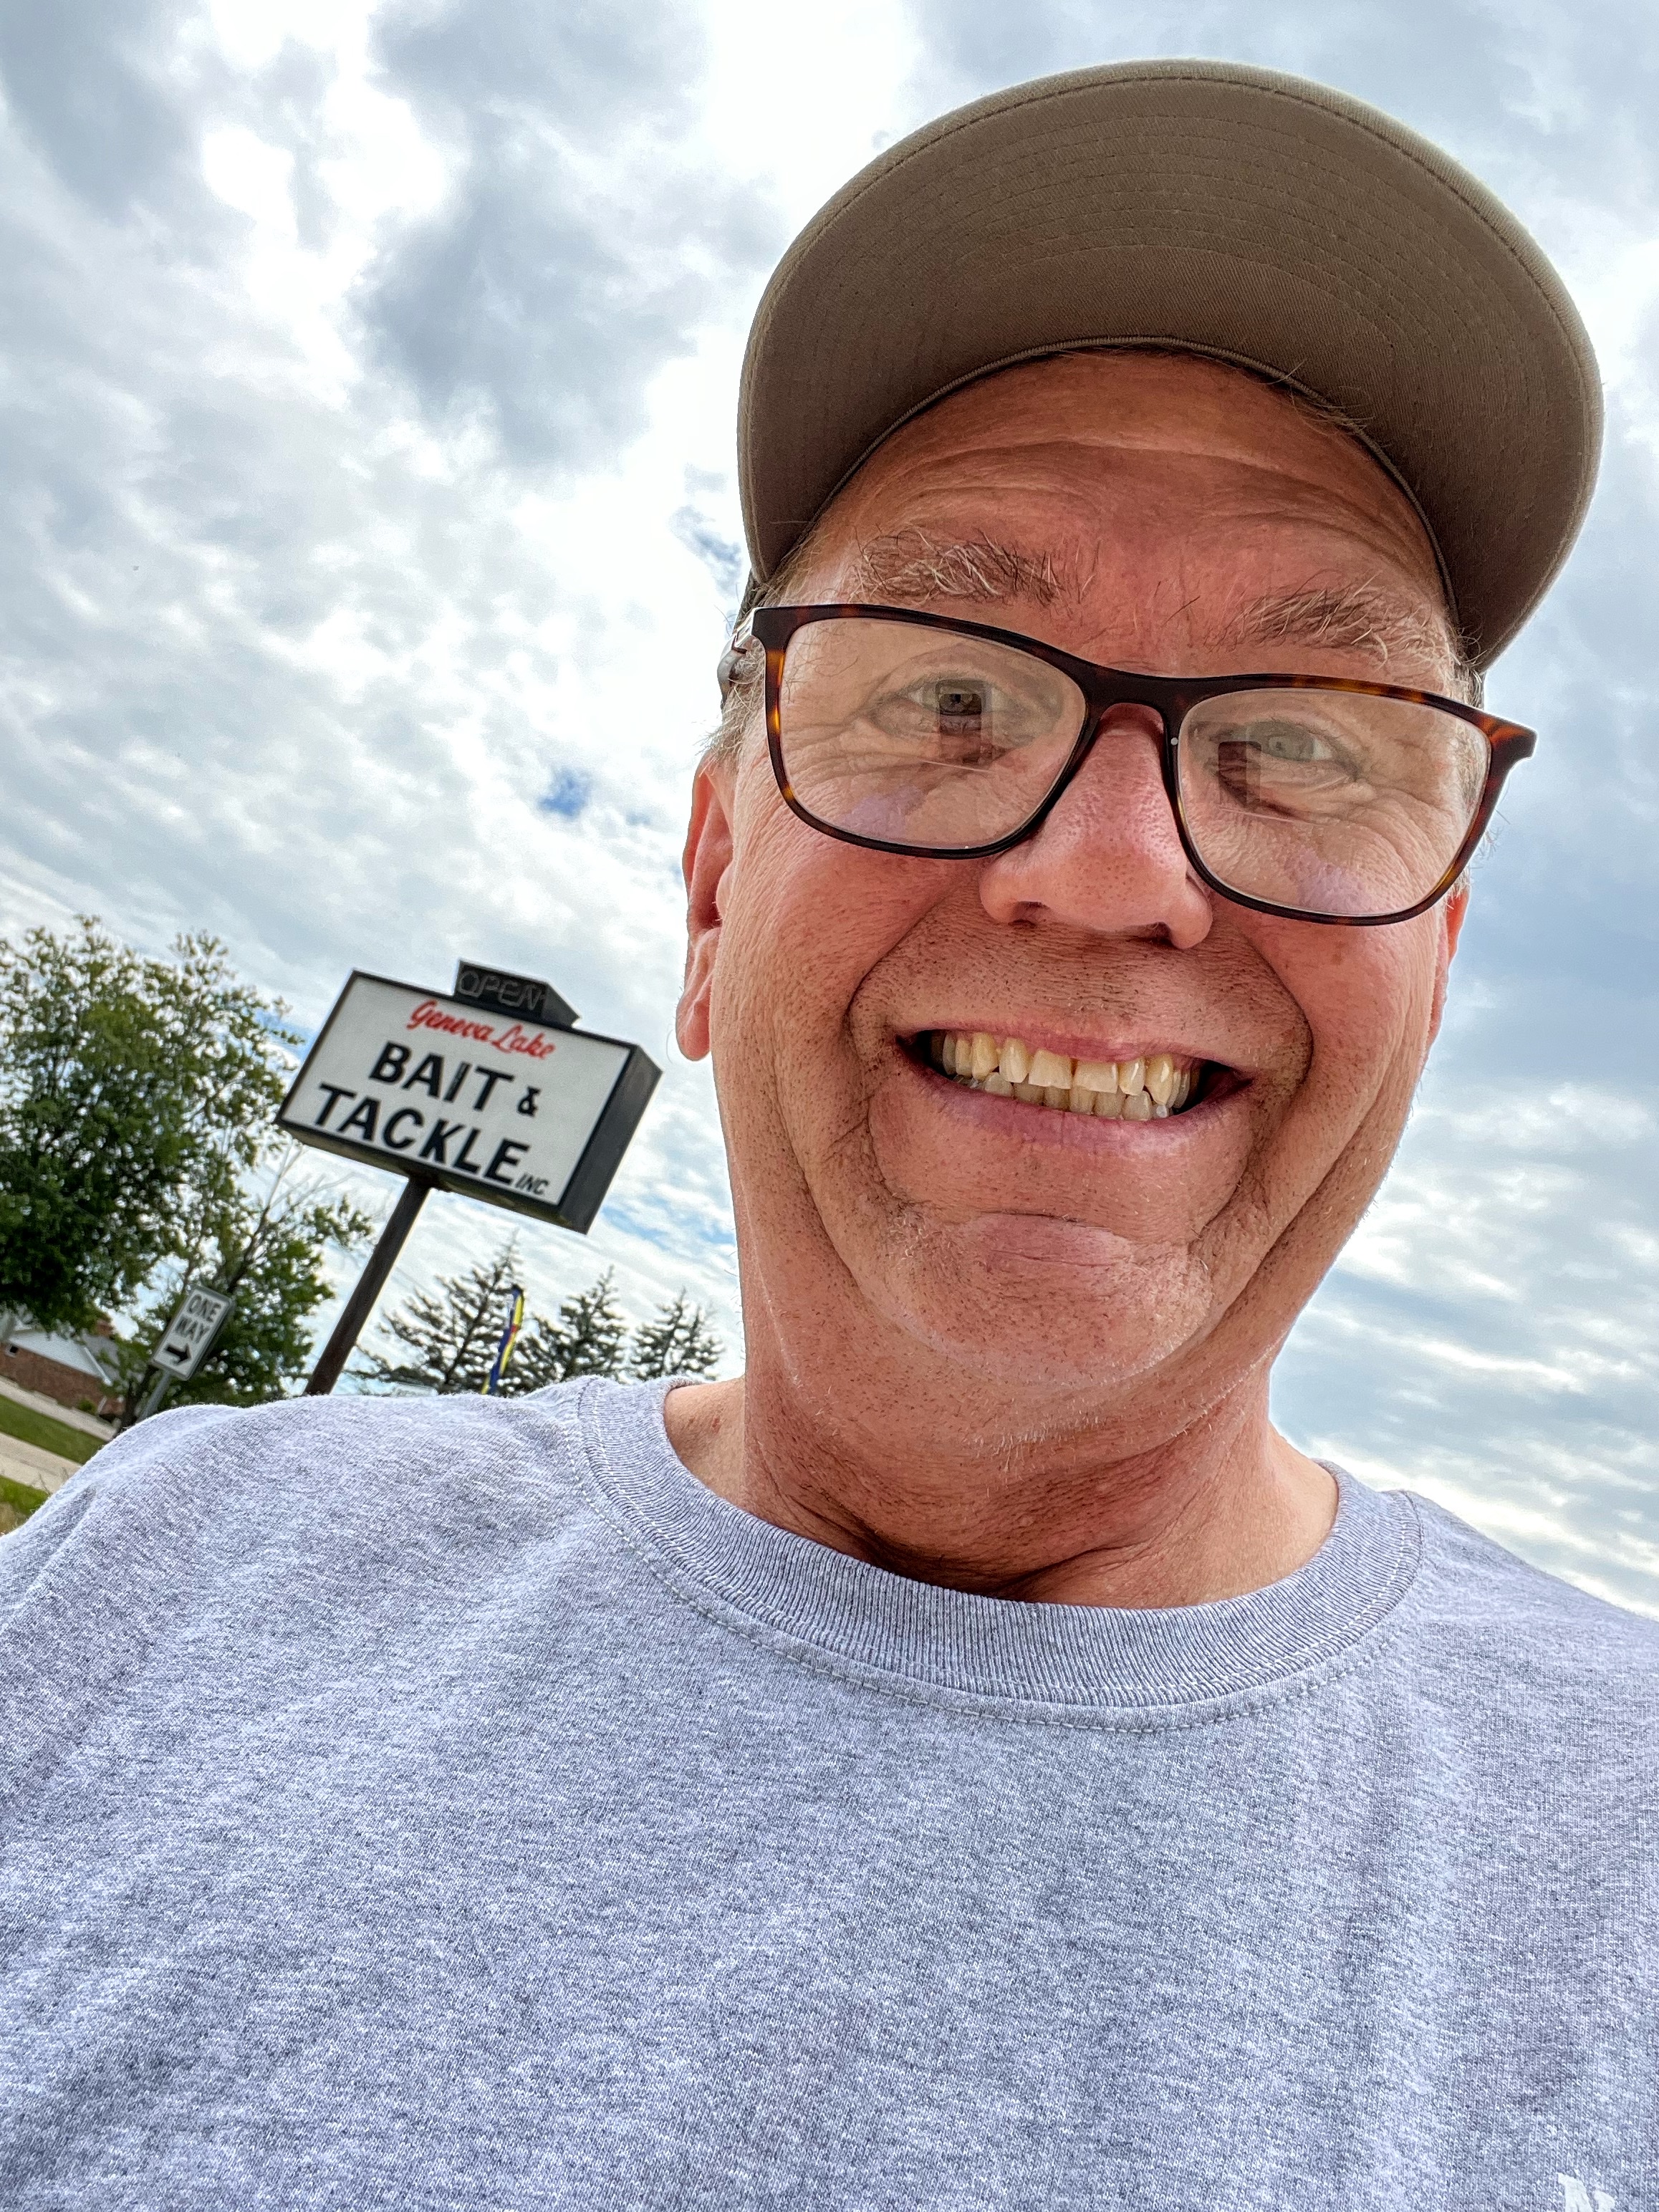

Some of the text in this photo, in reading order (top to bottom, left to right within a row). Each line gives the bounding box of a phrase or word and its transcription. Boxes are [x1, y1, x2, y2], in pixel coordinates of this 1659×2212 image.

[458, 969, 547, 1011] OPEN
[407, 1000, 556, 1059] Geneva Lake
[370, 1041, 541, 1117] BAIT &
[316, 1082, 549, 1196] TACKLE INC
[175, 1317, 210, 1343] WAY
[188, 1294, 221, 1323] ONE
